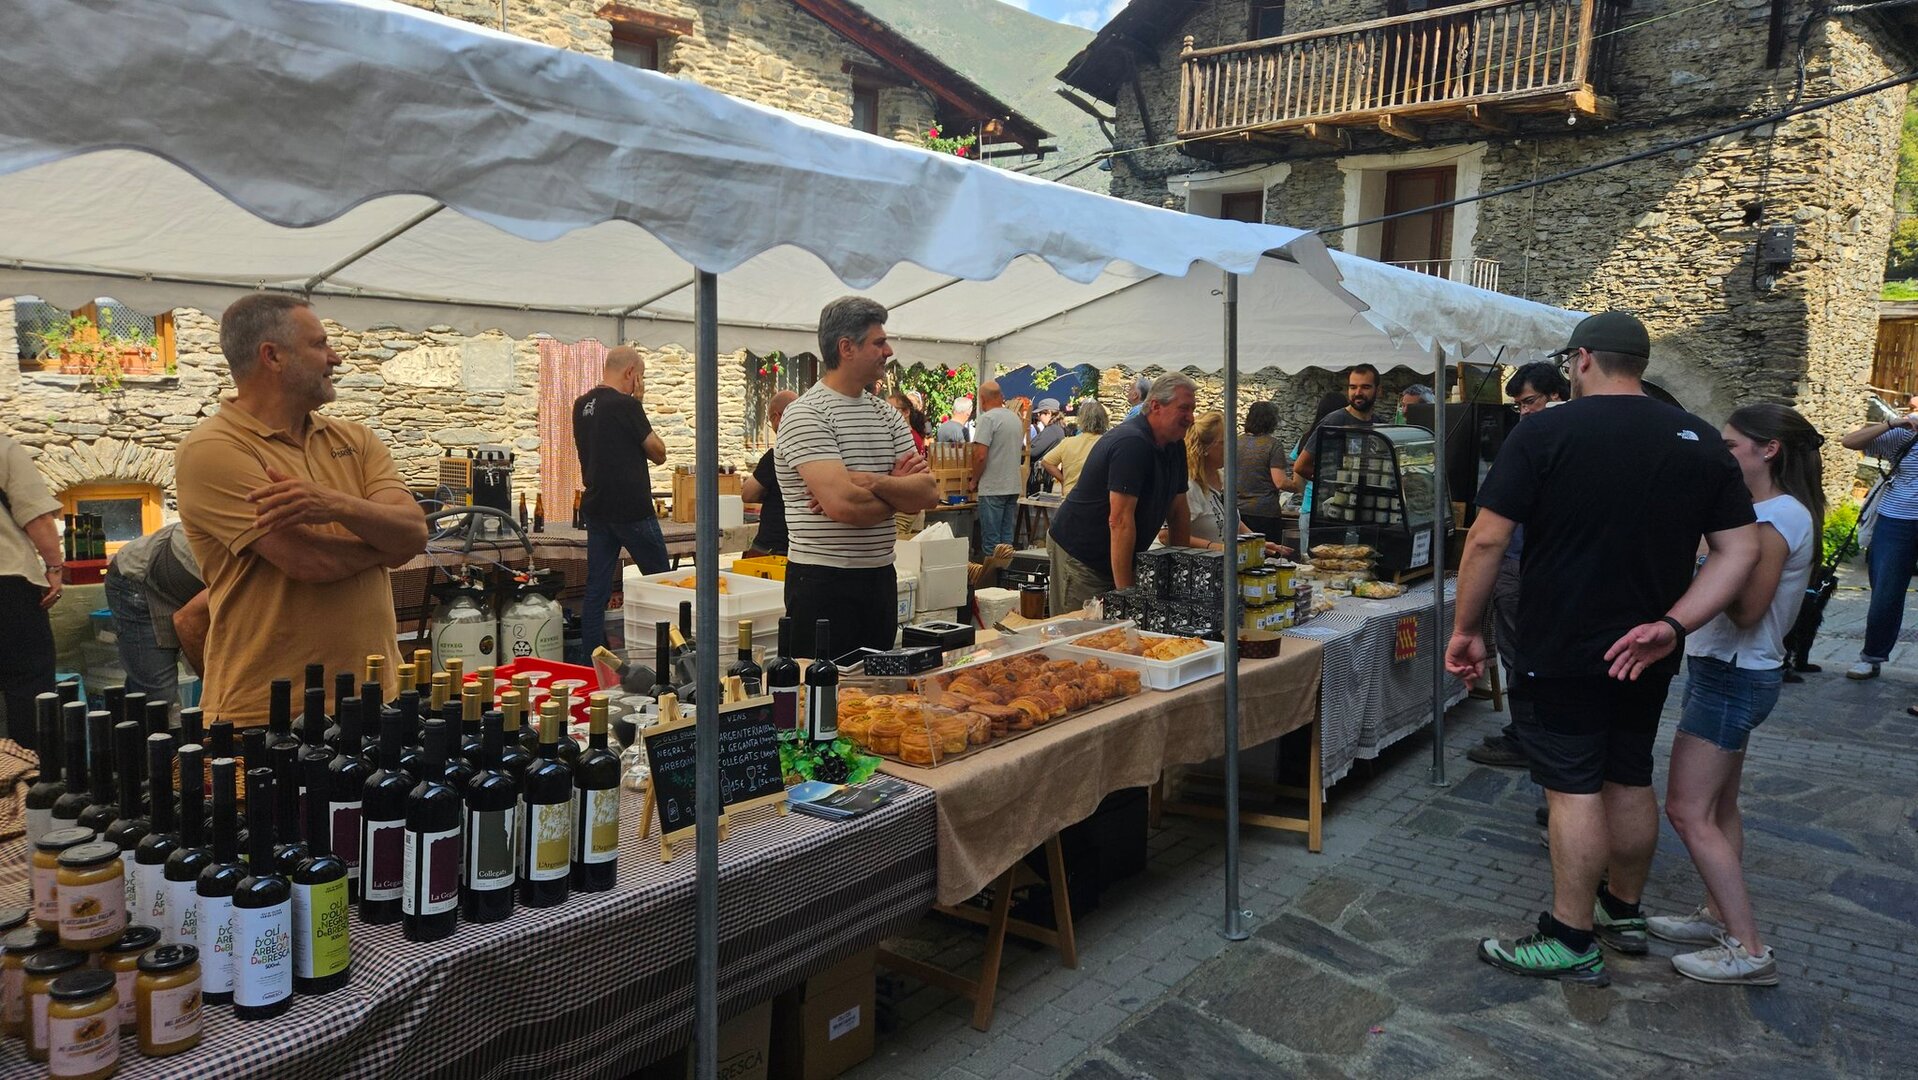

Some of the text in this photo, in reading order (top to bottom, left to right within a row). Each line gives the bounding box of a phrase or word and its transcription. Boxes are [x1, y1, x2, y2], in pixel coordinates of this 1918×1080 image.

[726, 713, 747, 723] VINS
[656, 745, 686, 758] NEGRAL
[728, 738, 759, 753] GEGANTA
